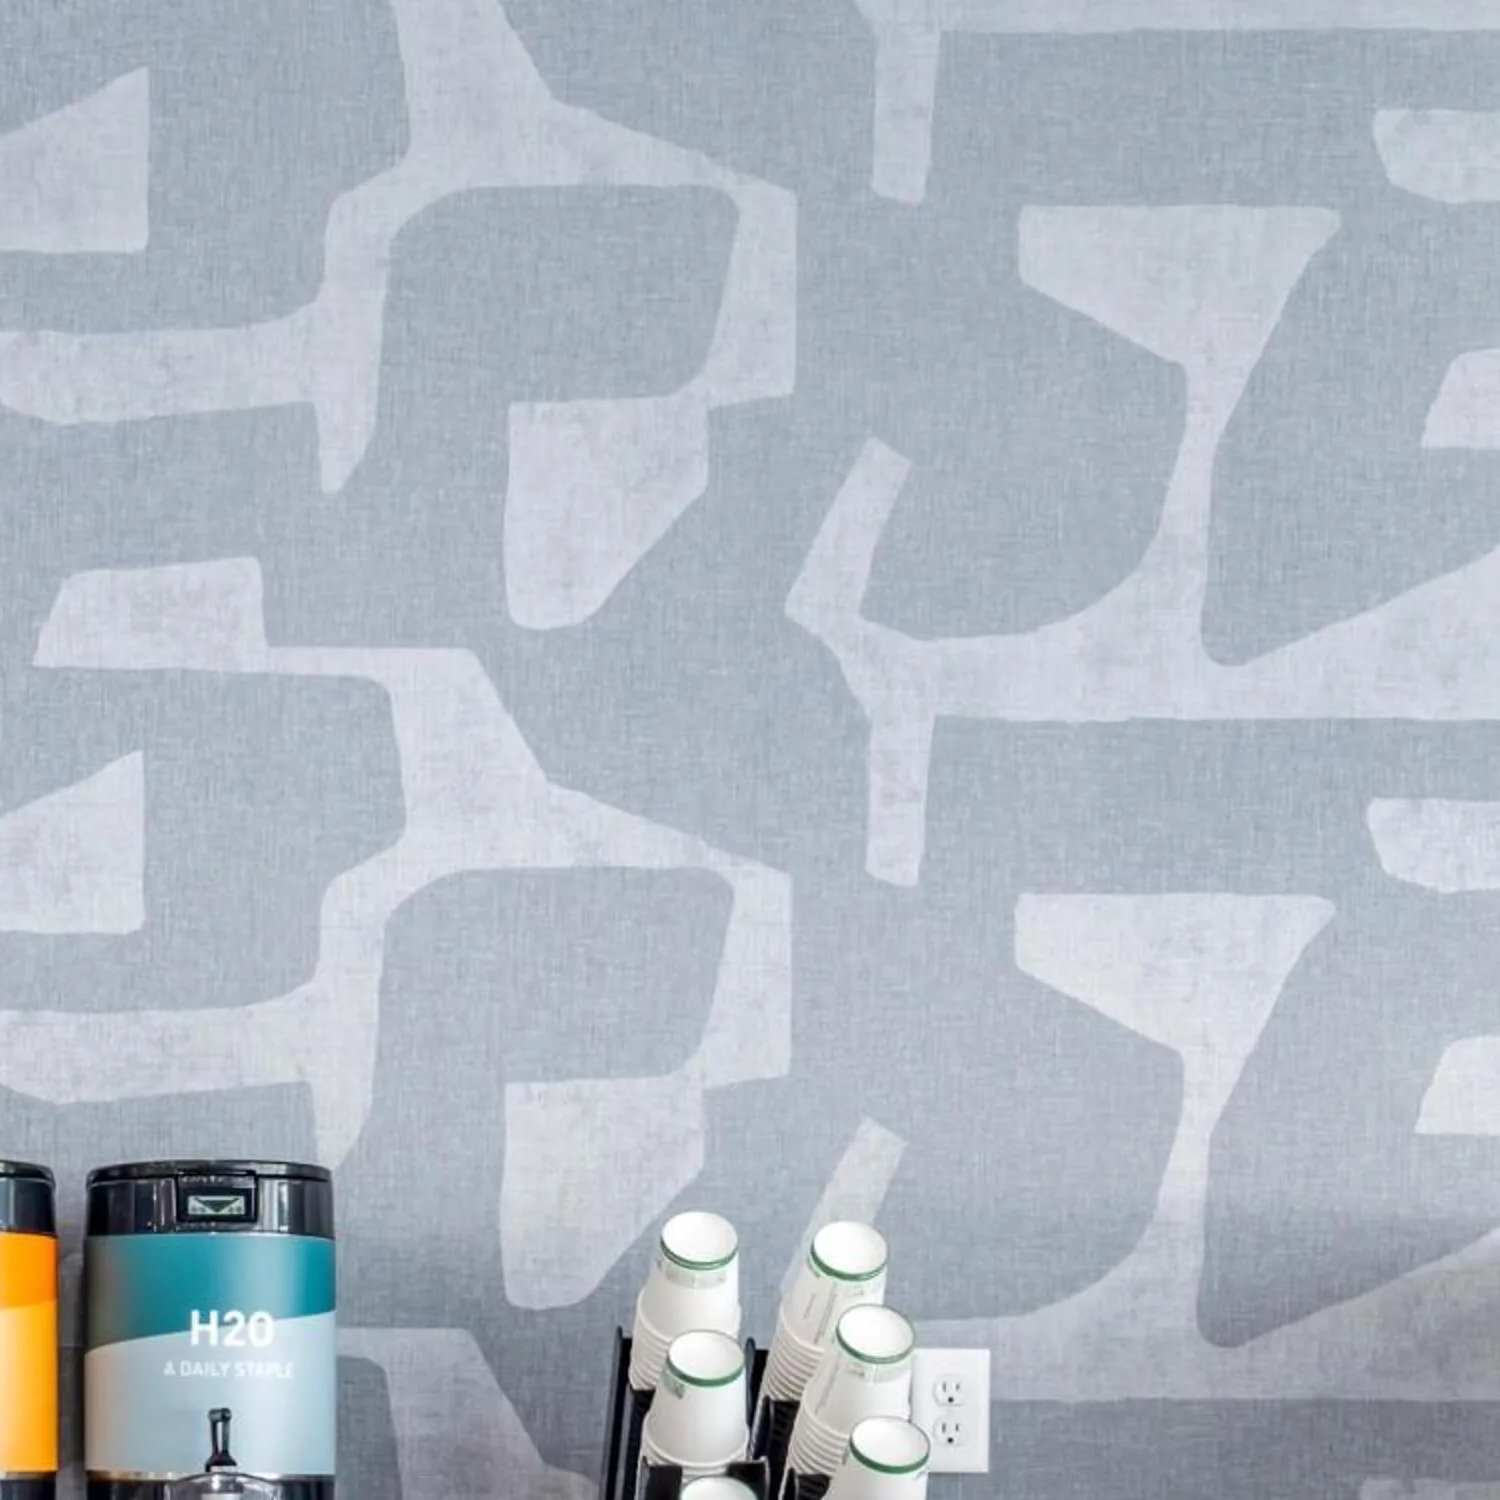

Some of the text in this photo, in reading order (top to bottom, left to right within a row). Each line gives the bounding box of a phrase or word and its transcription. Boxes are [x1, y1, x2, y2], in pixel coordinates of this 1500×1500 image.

[162, 1360, 294, 1380] A DAILY STAPLE
